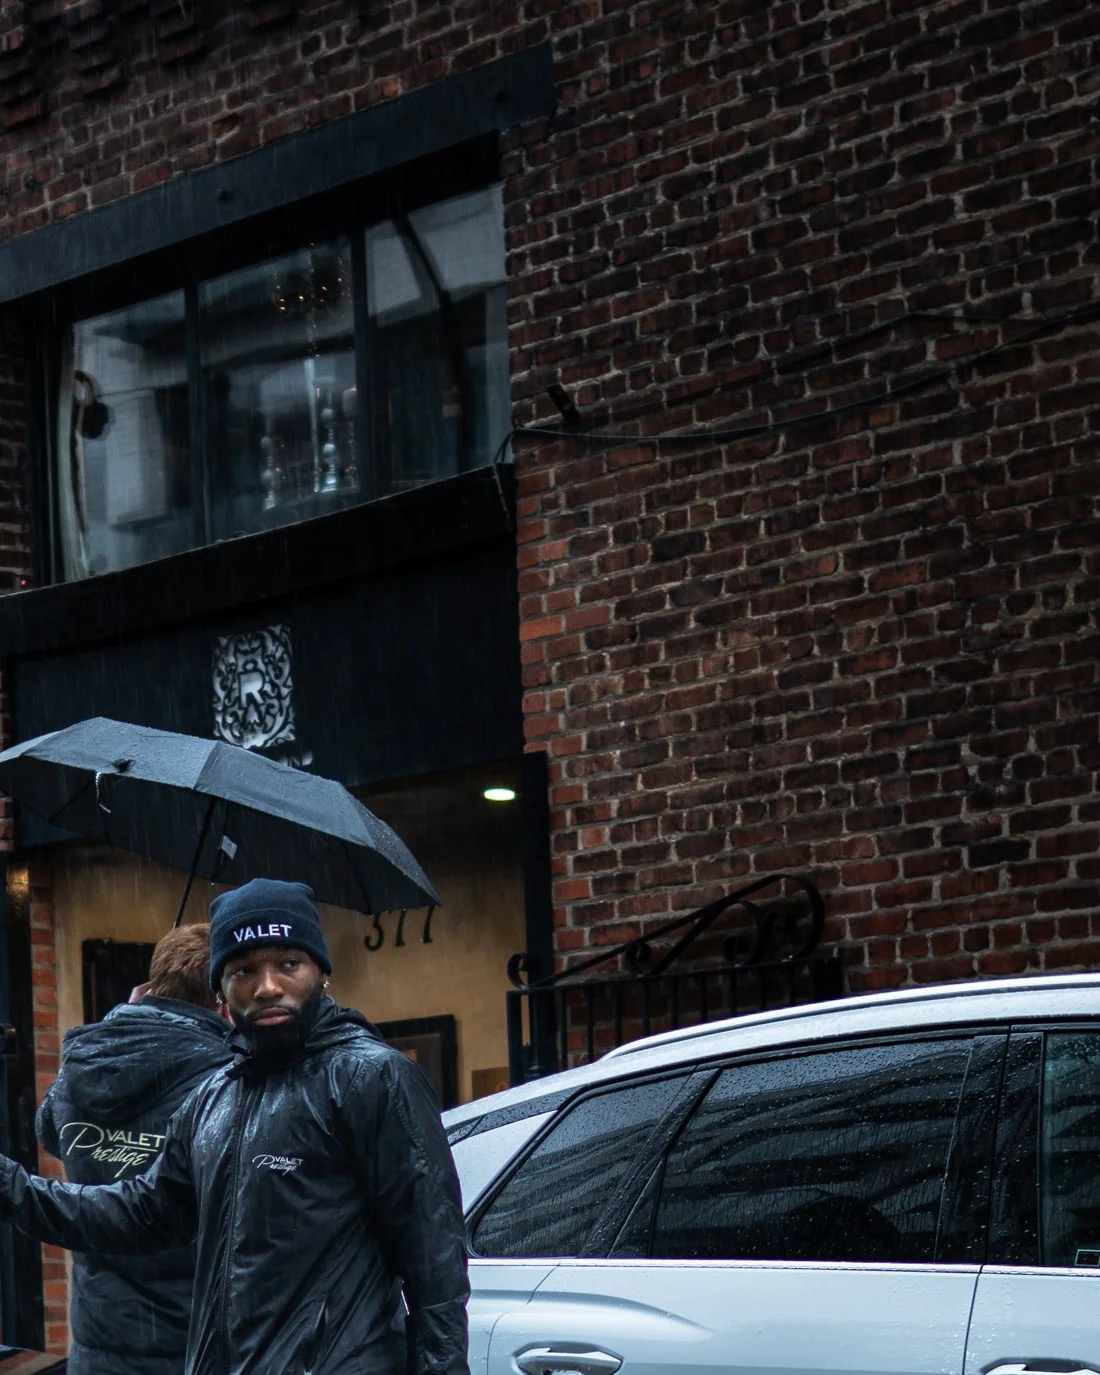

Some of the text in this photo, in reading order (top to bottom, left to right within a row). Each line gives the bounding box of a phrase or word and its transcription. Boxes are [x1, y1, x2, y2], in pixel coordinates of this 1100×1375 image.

[233, 924, 292, 942] VALET
[106, 1128, 166, 1148] VALET
[60, 1122, 150, 1178] Prestige
[275, 1156, 304, 1165] VALET
